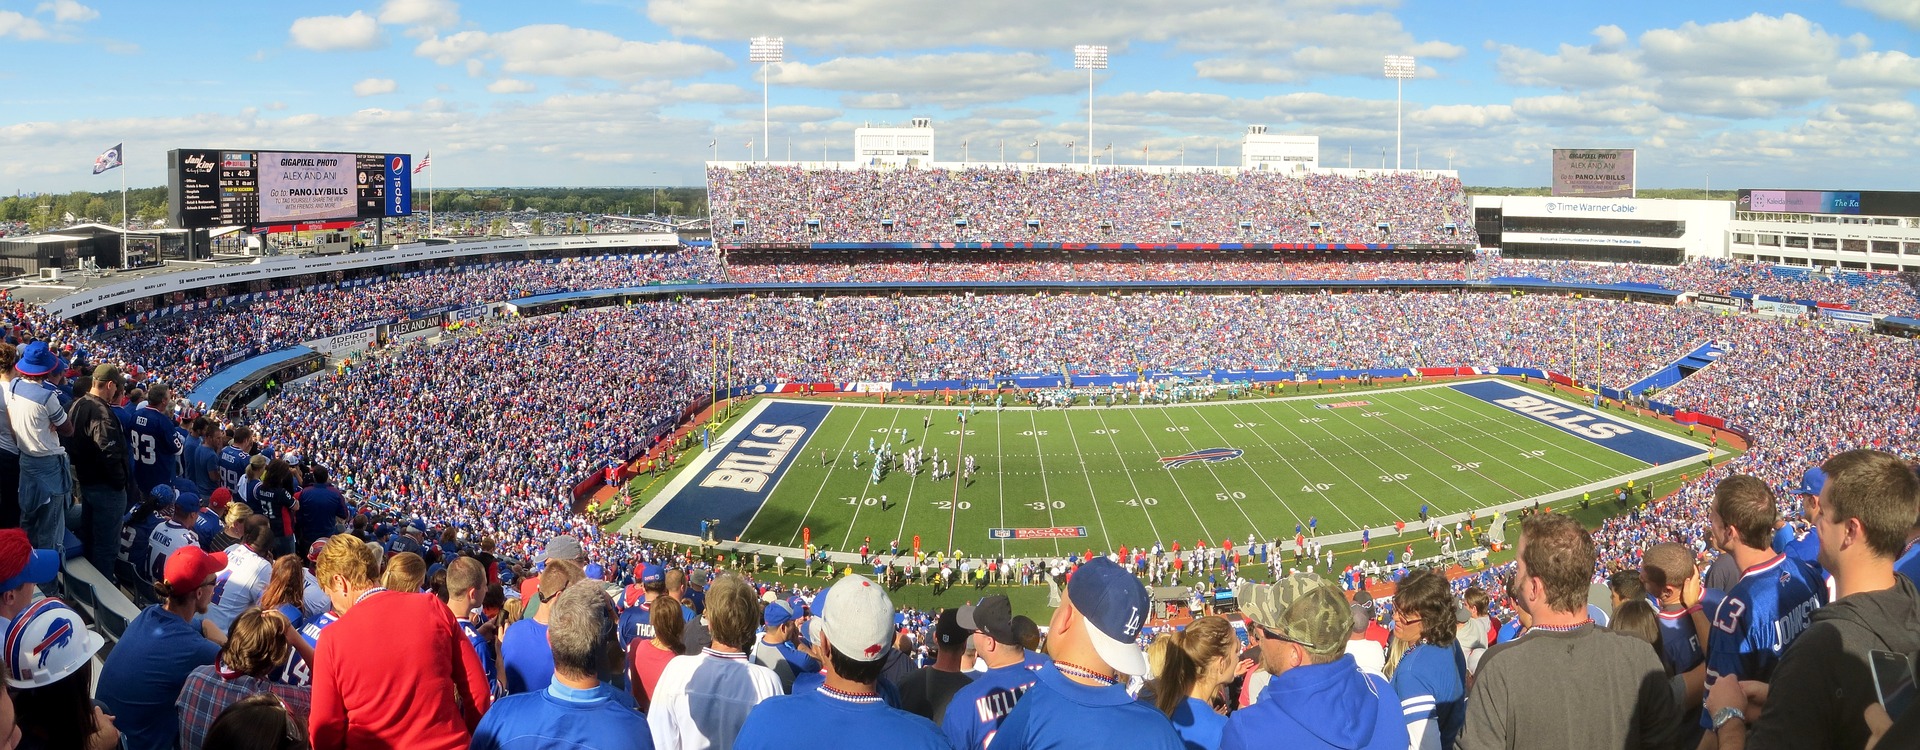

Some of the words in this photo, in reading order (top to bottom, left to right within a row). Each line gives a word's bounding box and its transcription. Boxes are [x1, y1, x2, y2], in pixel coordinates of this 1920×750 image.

[281, 158, 314, 167] GIGAPIXEL
[316, 158, 338, 167] PHOTO
[283, 172, 302, 180] ALEX
[304, 172, 322, 180] AND
[324, 171, 337, 180] ANI
[270, 189, 281, 197] Go
[289, 188, 349, 196] PANO.LY/BILLS
[394, 178, 403, 213] pepsi
[1557, 203, 1578, 211] Time
[1579, 203, 1610, 212] Warner
[1611, 204, 1635, 213] Cable
[1835, 199, 1848, 207] The
[456, 305, 488, 320] GEICO
[393, 324, 410, 335] ALEX
[410, 319, 427, 330] AND
[427, 316, 439, 327] ANI
[330, 332, 367, 347] ADPRO
[331, 339, 367, 350] SPORTS
[136, 416, 148, 428] REED
[1493, 395, 1633, 439] BILLS
[699, 423, 807, 493] BILLS
[1519, 449, 1544, 459] 10
[1452, 462, 1480, 472] 20
[1379, 473, 1407, 483] 30
[1301, 482, 1329, 493] 40
[1216, 491, 1246, 501] 50
[937, 500, 971, 510] 20
[1033, 501, 1066, 510] 30
[1125, 498, 1158, 507] 40
[1712, 595, 1746, 634] 13
[1124, 607, 1140, 645] LA
